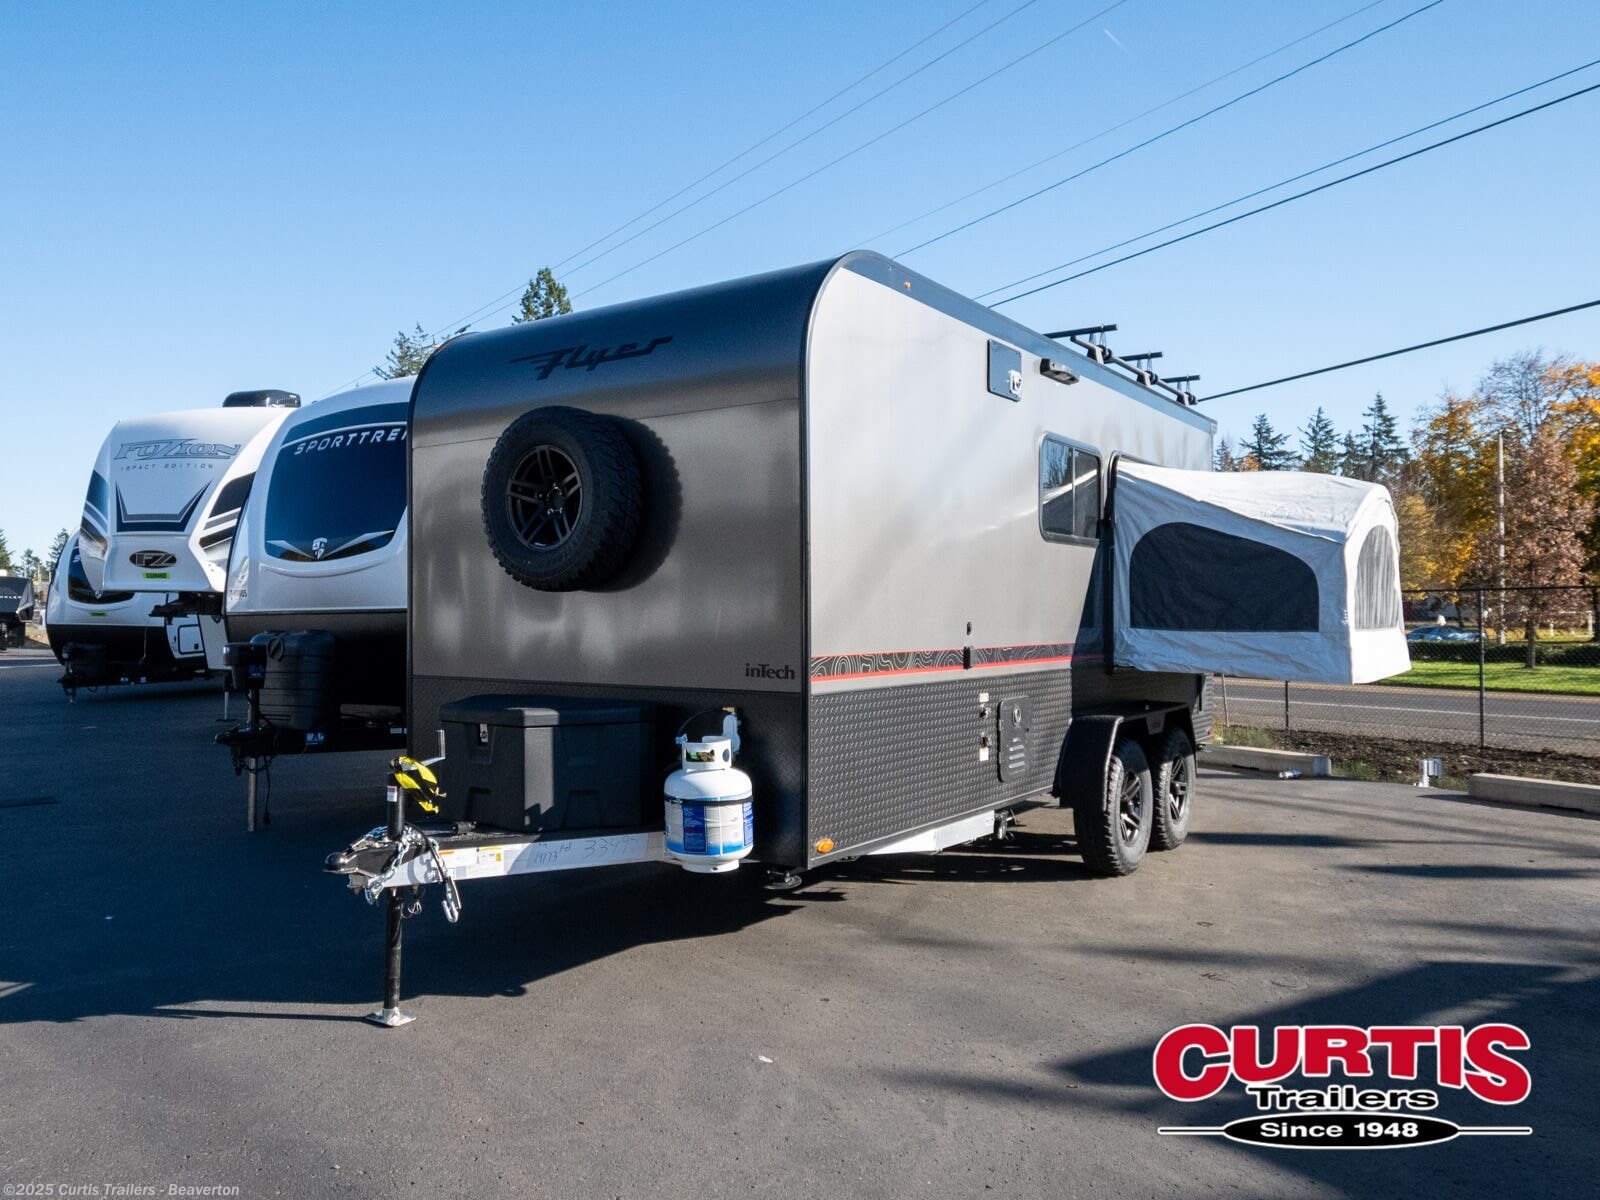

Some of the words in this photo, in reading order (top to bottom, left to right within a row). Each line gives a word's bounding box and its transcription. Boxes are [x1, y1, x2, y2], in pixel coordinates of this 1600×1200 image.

[509, 336, 674, 381] Flyer
[163, 462, 215, 470] EDITION
[745, 662, 796, 680] inTech
